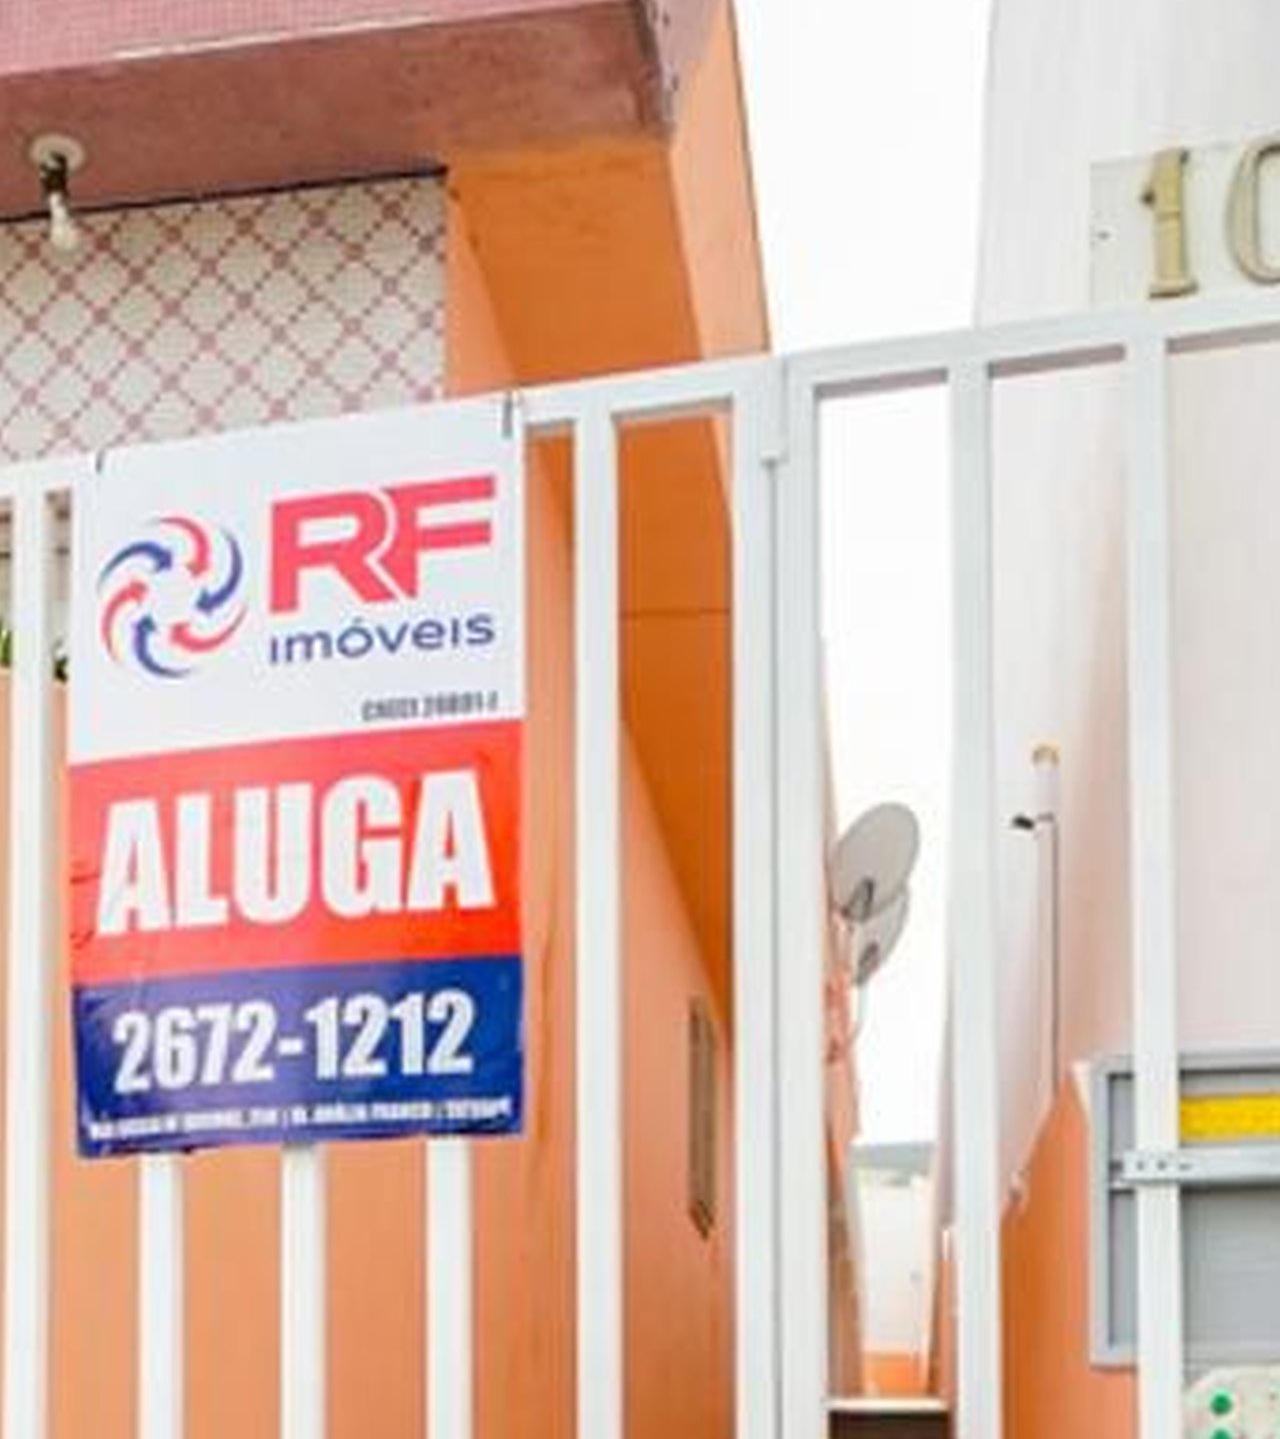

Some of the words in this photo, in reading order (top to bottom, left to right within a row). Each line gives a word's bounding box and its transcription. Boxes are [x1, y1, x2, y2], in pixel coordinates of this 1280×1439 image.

[268, 475, 497, 616] RF
[267, 610, 496, 667] imóveis
[96, 769, 498, 937] ALUGA
[112, 989, 477, 1095] 2672-1212
